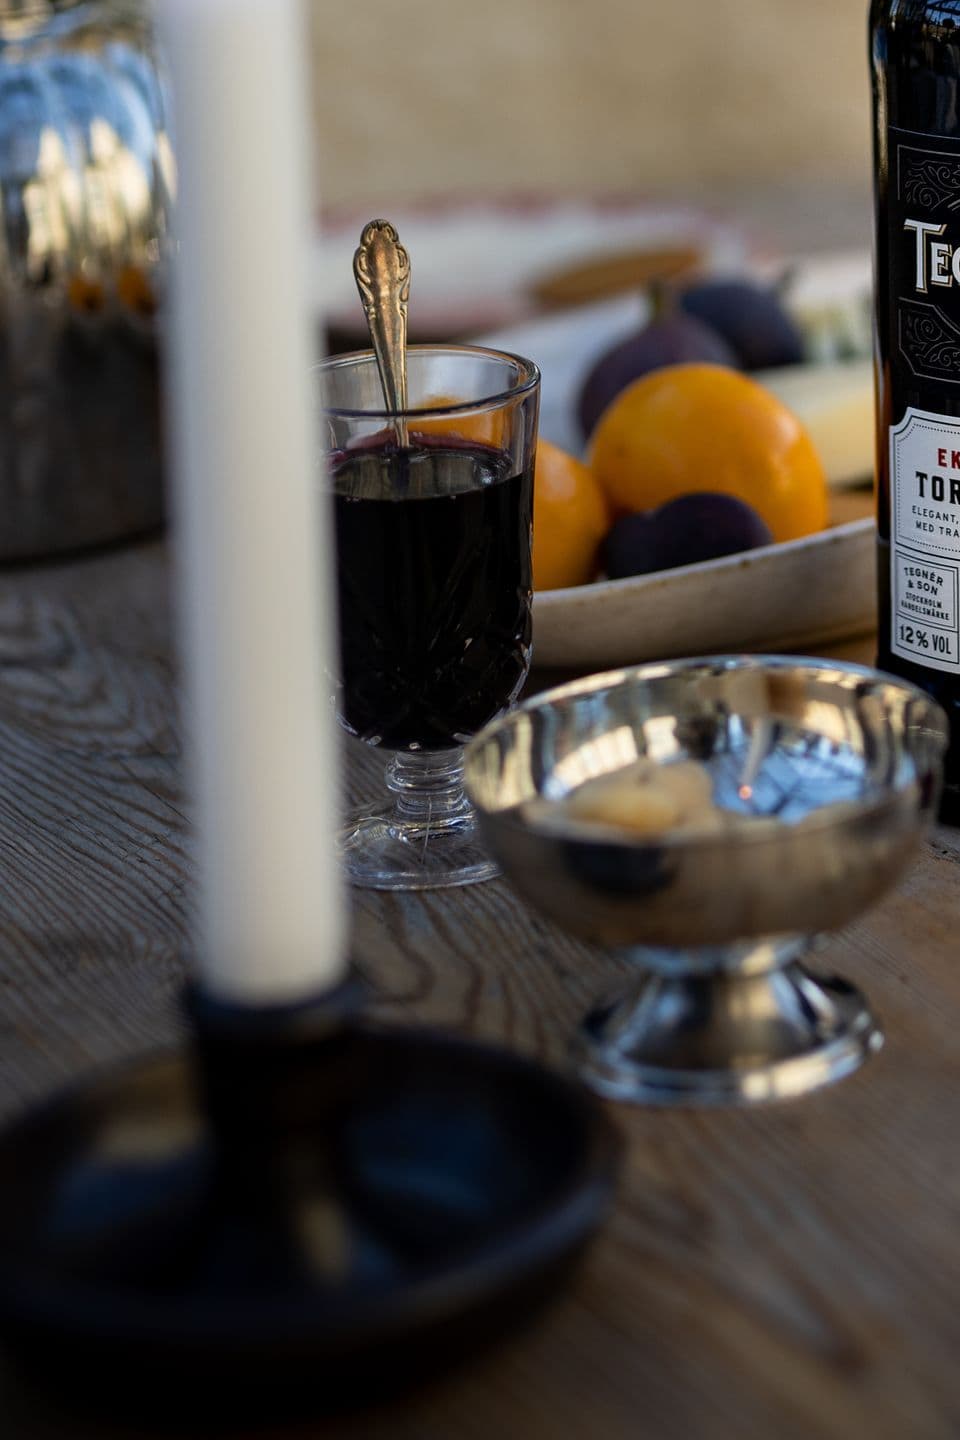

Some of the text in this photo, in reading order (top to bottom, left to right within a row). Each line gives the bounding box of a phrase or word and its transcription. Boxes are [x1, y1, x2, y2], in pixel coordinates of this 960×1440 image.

[911, 505, 959, 525] ELEGANT,
[916, 520, 935, 533] MED
[904, 566, 944, 587] TEGNÉR
[917, 580, 939, 596] SON
[932, 634, 952, 655] VOL
